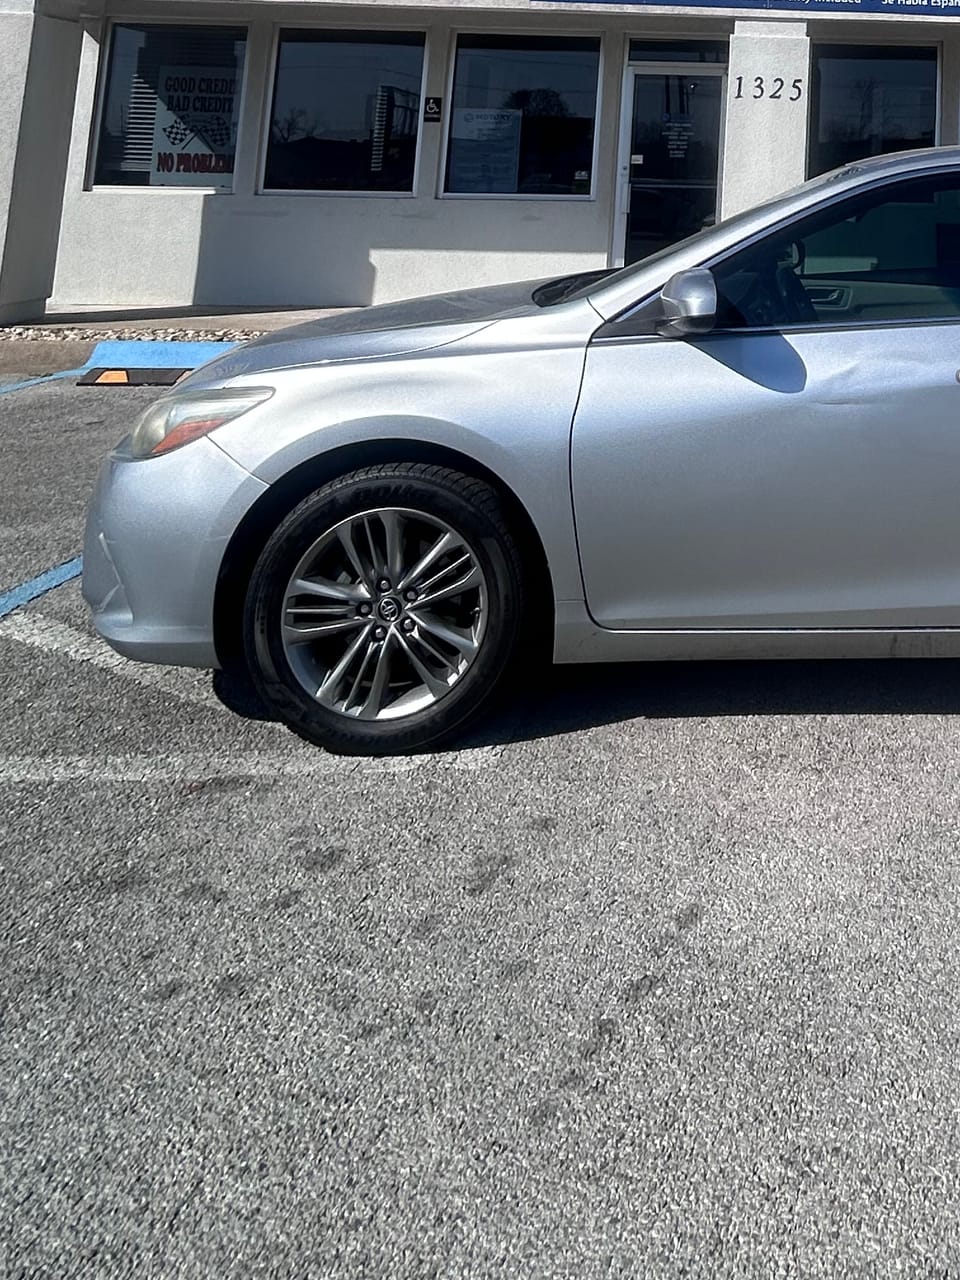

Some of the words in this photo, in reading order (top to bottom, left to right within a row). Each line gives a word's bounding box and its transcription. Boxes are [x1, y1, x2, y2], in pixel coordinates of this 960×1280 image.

[165, 77, 196, 93] GOOD
[735, 76, 802, 101] 1325
[167, 95, 190, 112] BAD
[193, 96, 234, 113] CREDIT
[157, 152, 175, 173] NO
